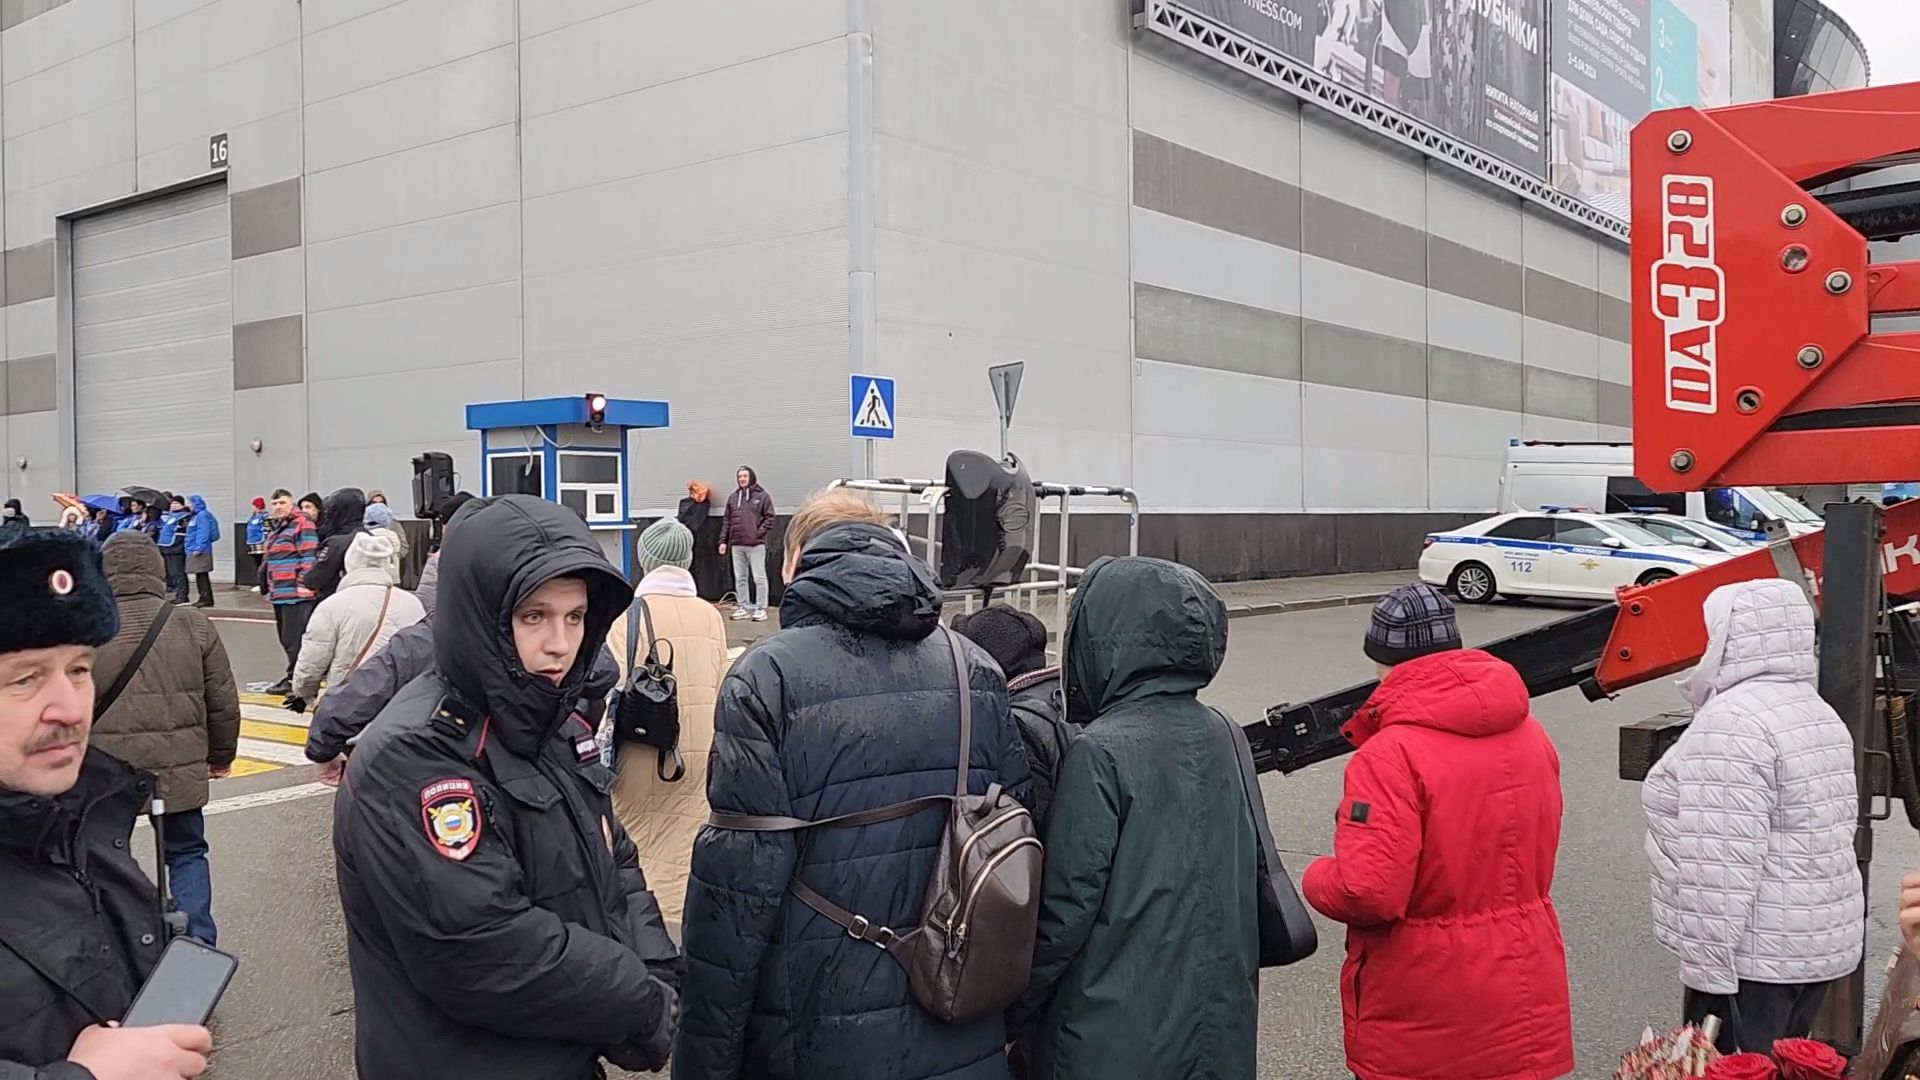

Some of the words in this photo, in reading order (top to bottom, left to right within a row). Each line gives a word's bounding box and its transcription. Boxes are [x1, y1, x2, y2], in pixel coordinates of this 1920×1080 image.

[1244, 0, 1302, 32] NESS.COM
[211, 139, 228, 162] 16
[1511, 561, 1532, 573] 112
